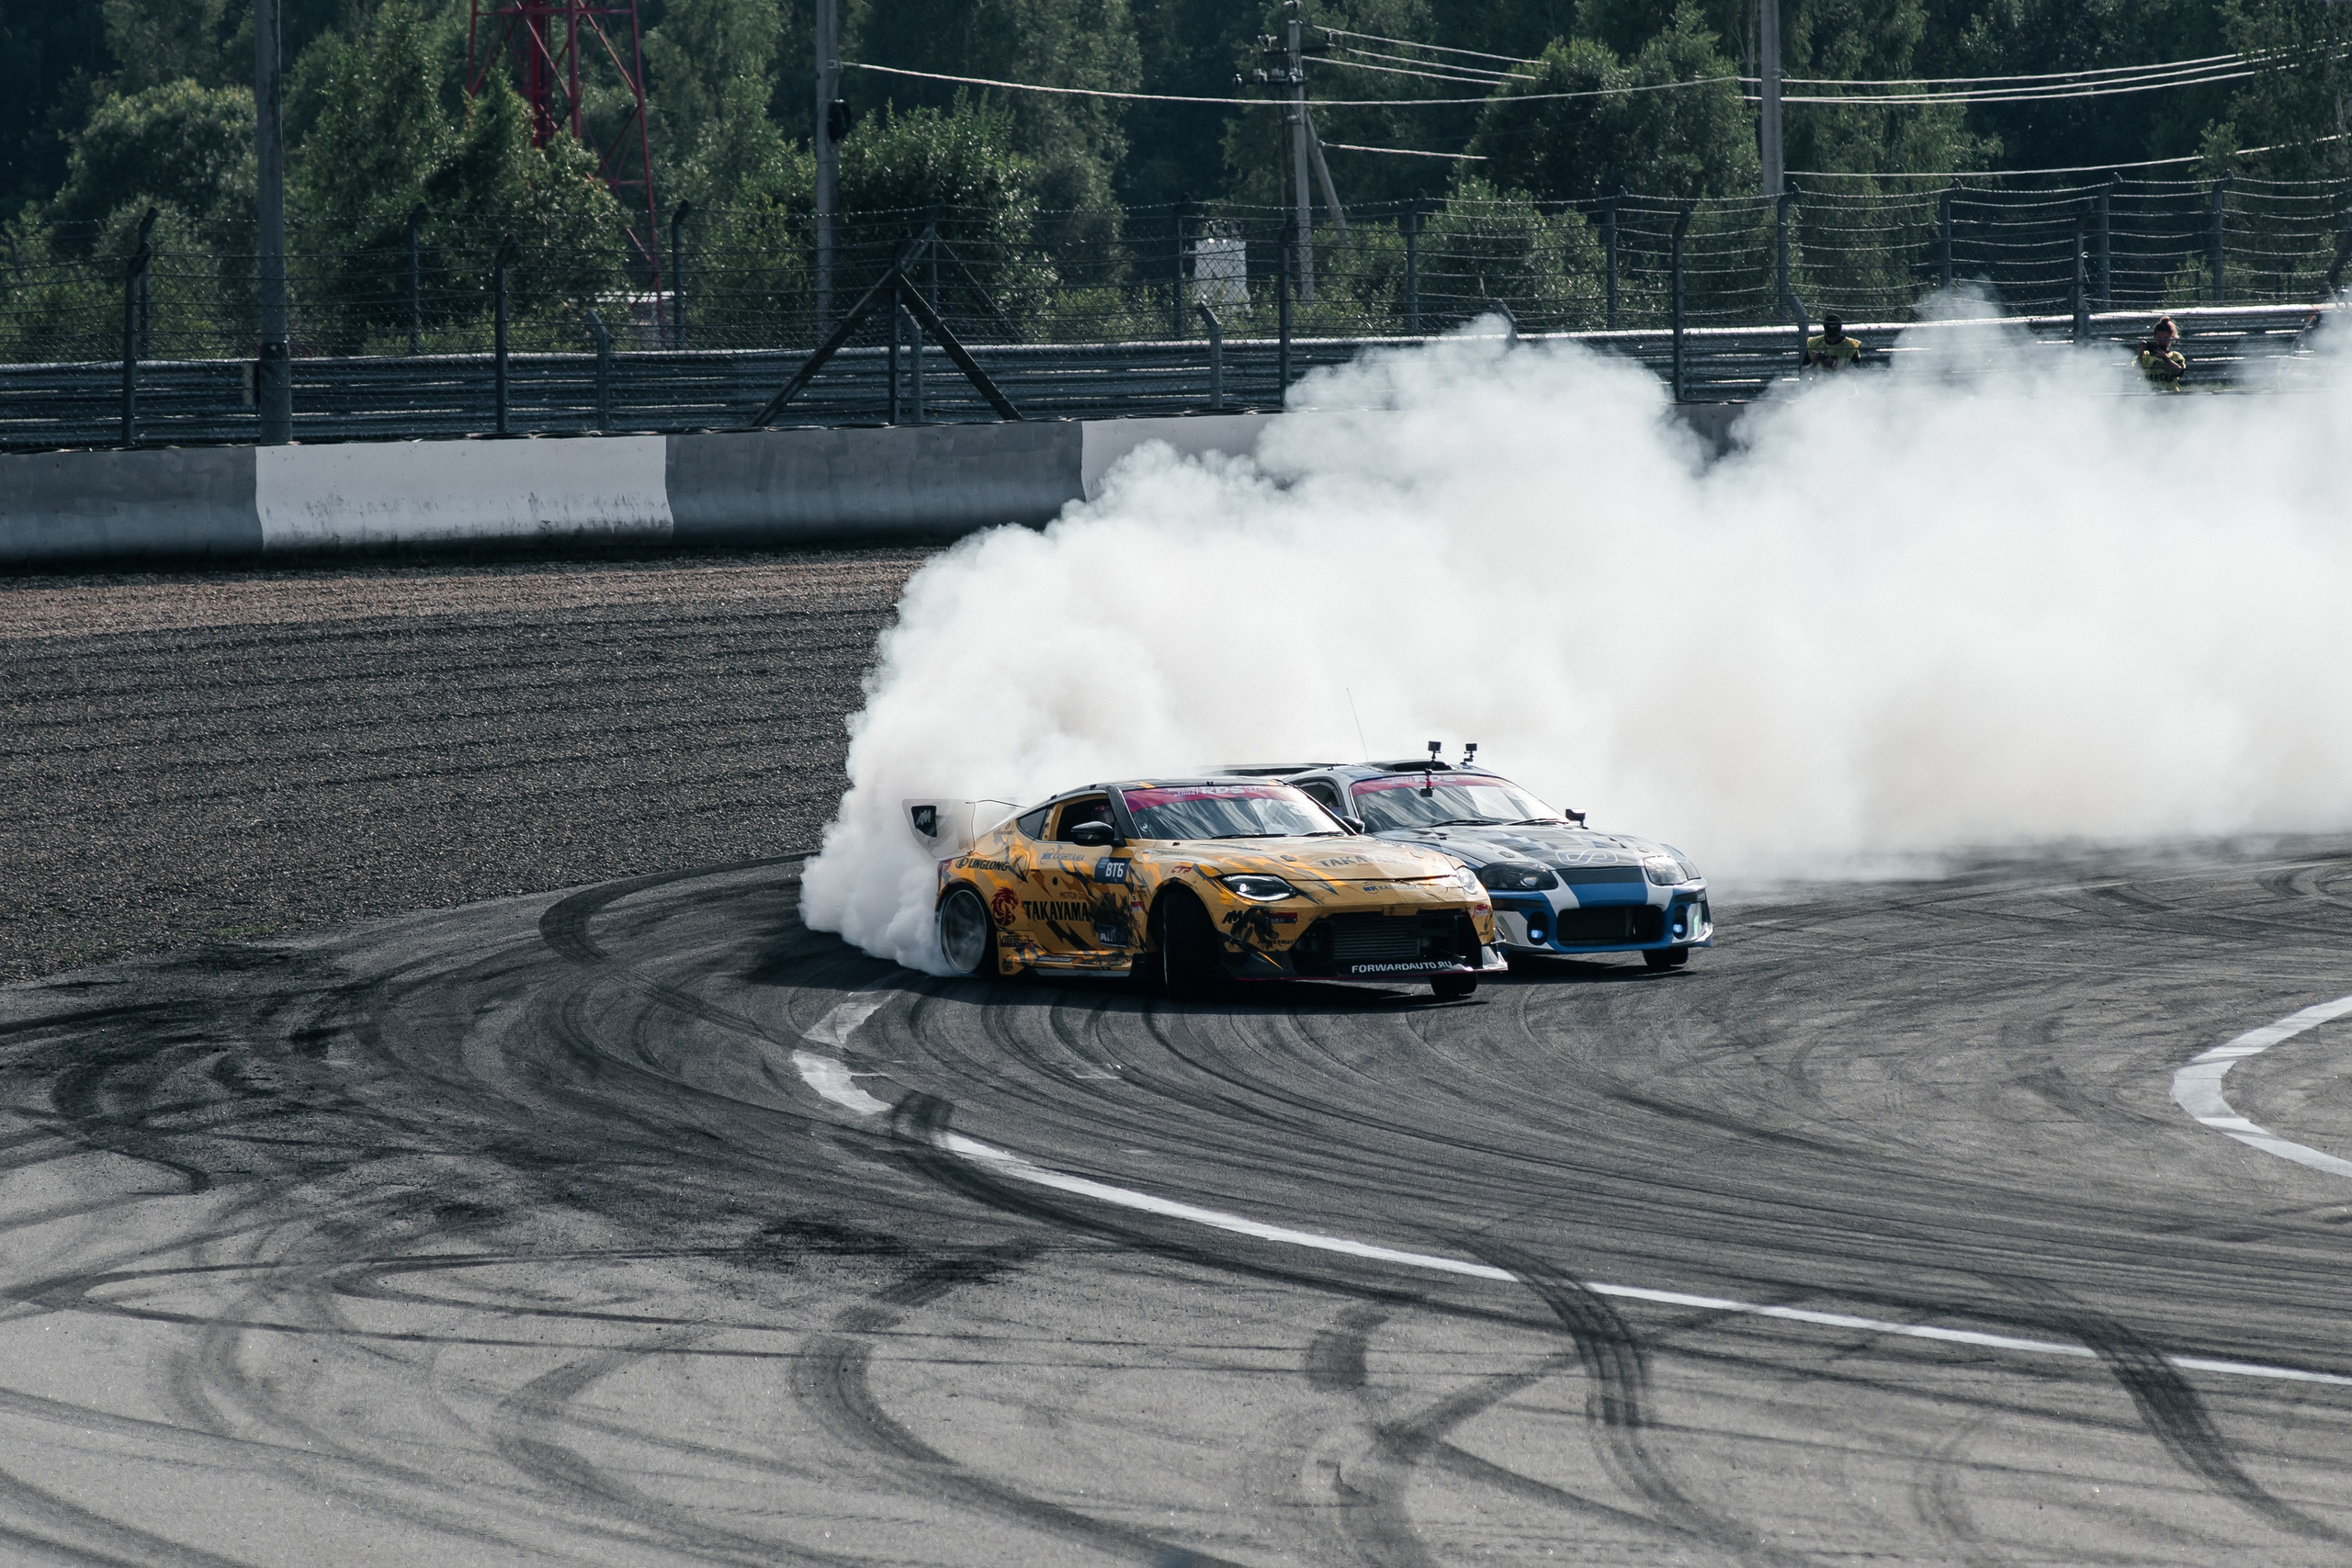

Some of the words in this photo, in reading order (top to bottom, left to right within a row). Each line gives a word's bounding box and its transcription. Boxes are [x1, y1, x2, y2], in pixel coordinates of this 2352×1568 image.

[1200, 786, 1245, 795] RDS
[967, 860, 1010, 872] LINGLONG
[1105, 863, 1125, 878] ВТБ
[1022, 900, 1091, 922] TAKAYAMA
[1351, 961, 1453, 974] FORWARDAUTO.RU
